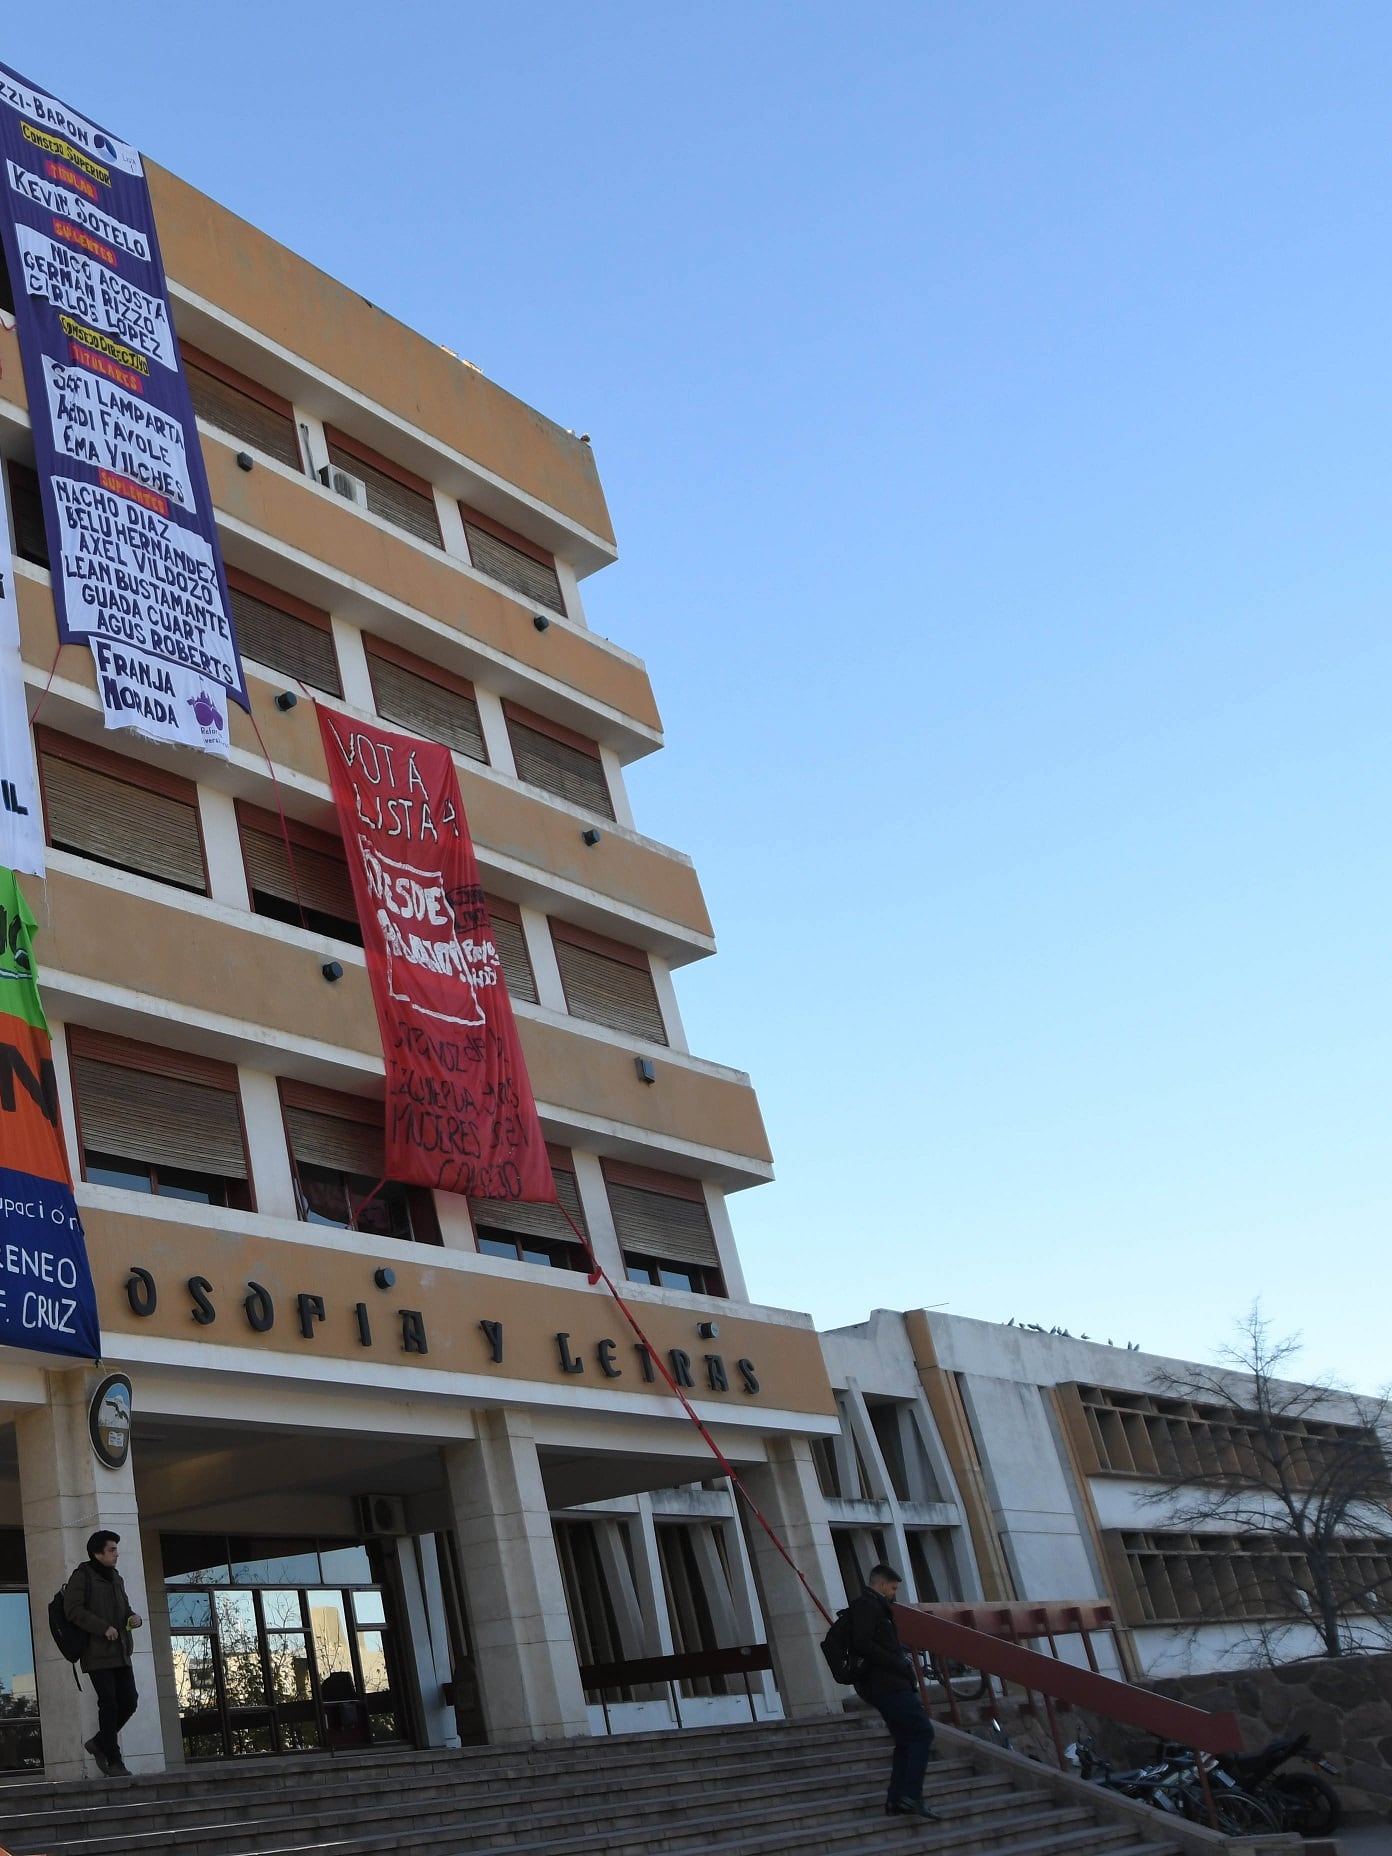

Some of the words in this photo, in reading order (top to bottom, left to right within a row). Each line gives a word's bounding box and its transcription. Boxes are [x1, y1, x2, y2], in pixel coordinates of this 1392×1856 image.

[67, 146, 111, 186] SUPERIOR
[12, 164, 70, 216] KEVIN
[75, 198, 146, 259] SOTELO
[24, 251, 96, 302] GERMAN
[102, 292, 155, 335] RIZZO
[50, 243, 92, 281] NICO
[99, 269, 166, 323] ACOSTA
[108, 309, 163, 360] LOPEZ
[95, 380, 185, 450] LAMPARTA
[64, 425, 101, 464] EMA
[104, 440, 184, 502] VILCHES
[56, 480, 119, 518] NACHO
[127, 504, 171, 542] DIAZ
[66, 506, 111, 538] BELU
[117, 519, 218, 589] HERNANDEZ
[65, 555, 112, 586] LEAN
[115, 568, 229, 641] BUSTAMANTE
[79, 532, 128, 567] AXEL
[132, 549, 213, 606] VILDOZO
[82, 584, 144, 621] GUADA
[147, 604, 206, 648] CUART
[97, 610, 146, 645] AGUS
[152, 629, 234, 685] ROBERTS
[96, 640, 176, 698] FRANJA
[102, 676, 179, 729] MORADA
[328, 719, 428, 800] VOTÁ
[354, 783, 437, 843] LISTA
[22, 1291, 77, 1335] CRUZ
[478, 1319, 503, 1364] Y
[555, 1331, 760, 1396] LETRAS
